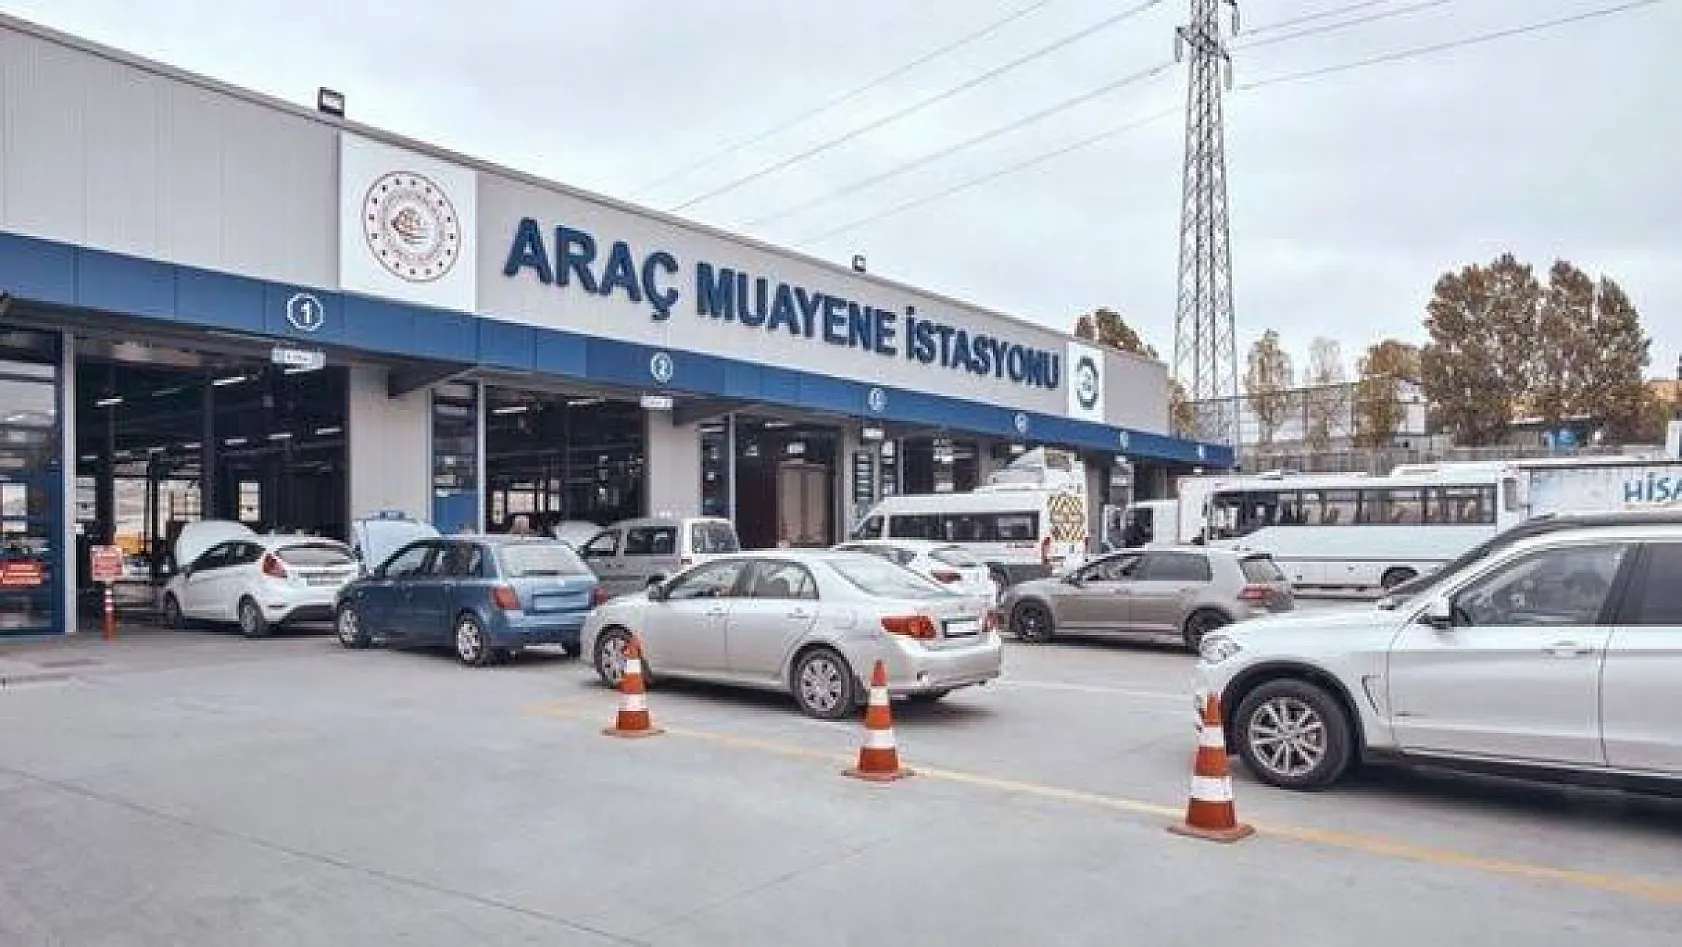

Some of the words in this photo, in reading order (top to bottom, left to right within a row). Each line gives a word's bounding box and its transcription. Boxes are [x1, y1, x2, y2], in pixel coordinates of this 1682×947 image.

[300, 300, 313, 324] 1
[503, 217, 679, 321] ARAÇ
[696, 262, 897, 356] MUAYENE
[906, 306, 1059, 390] İSTASYONU
